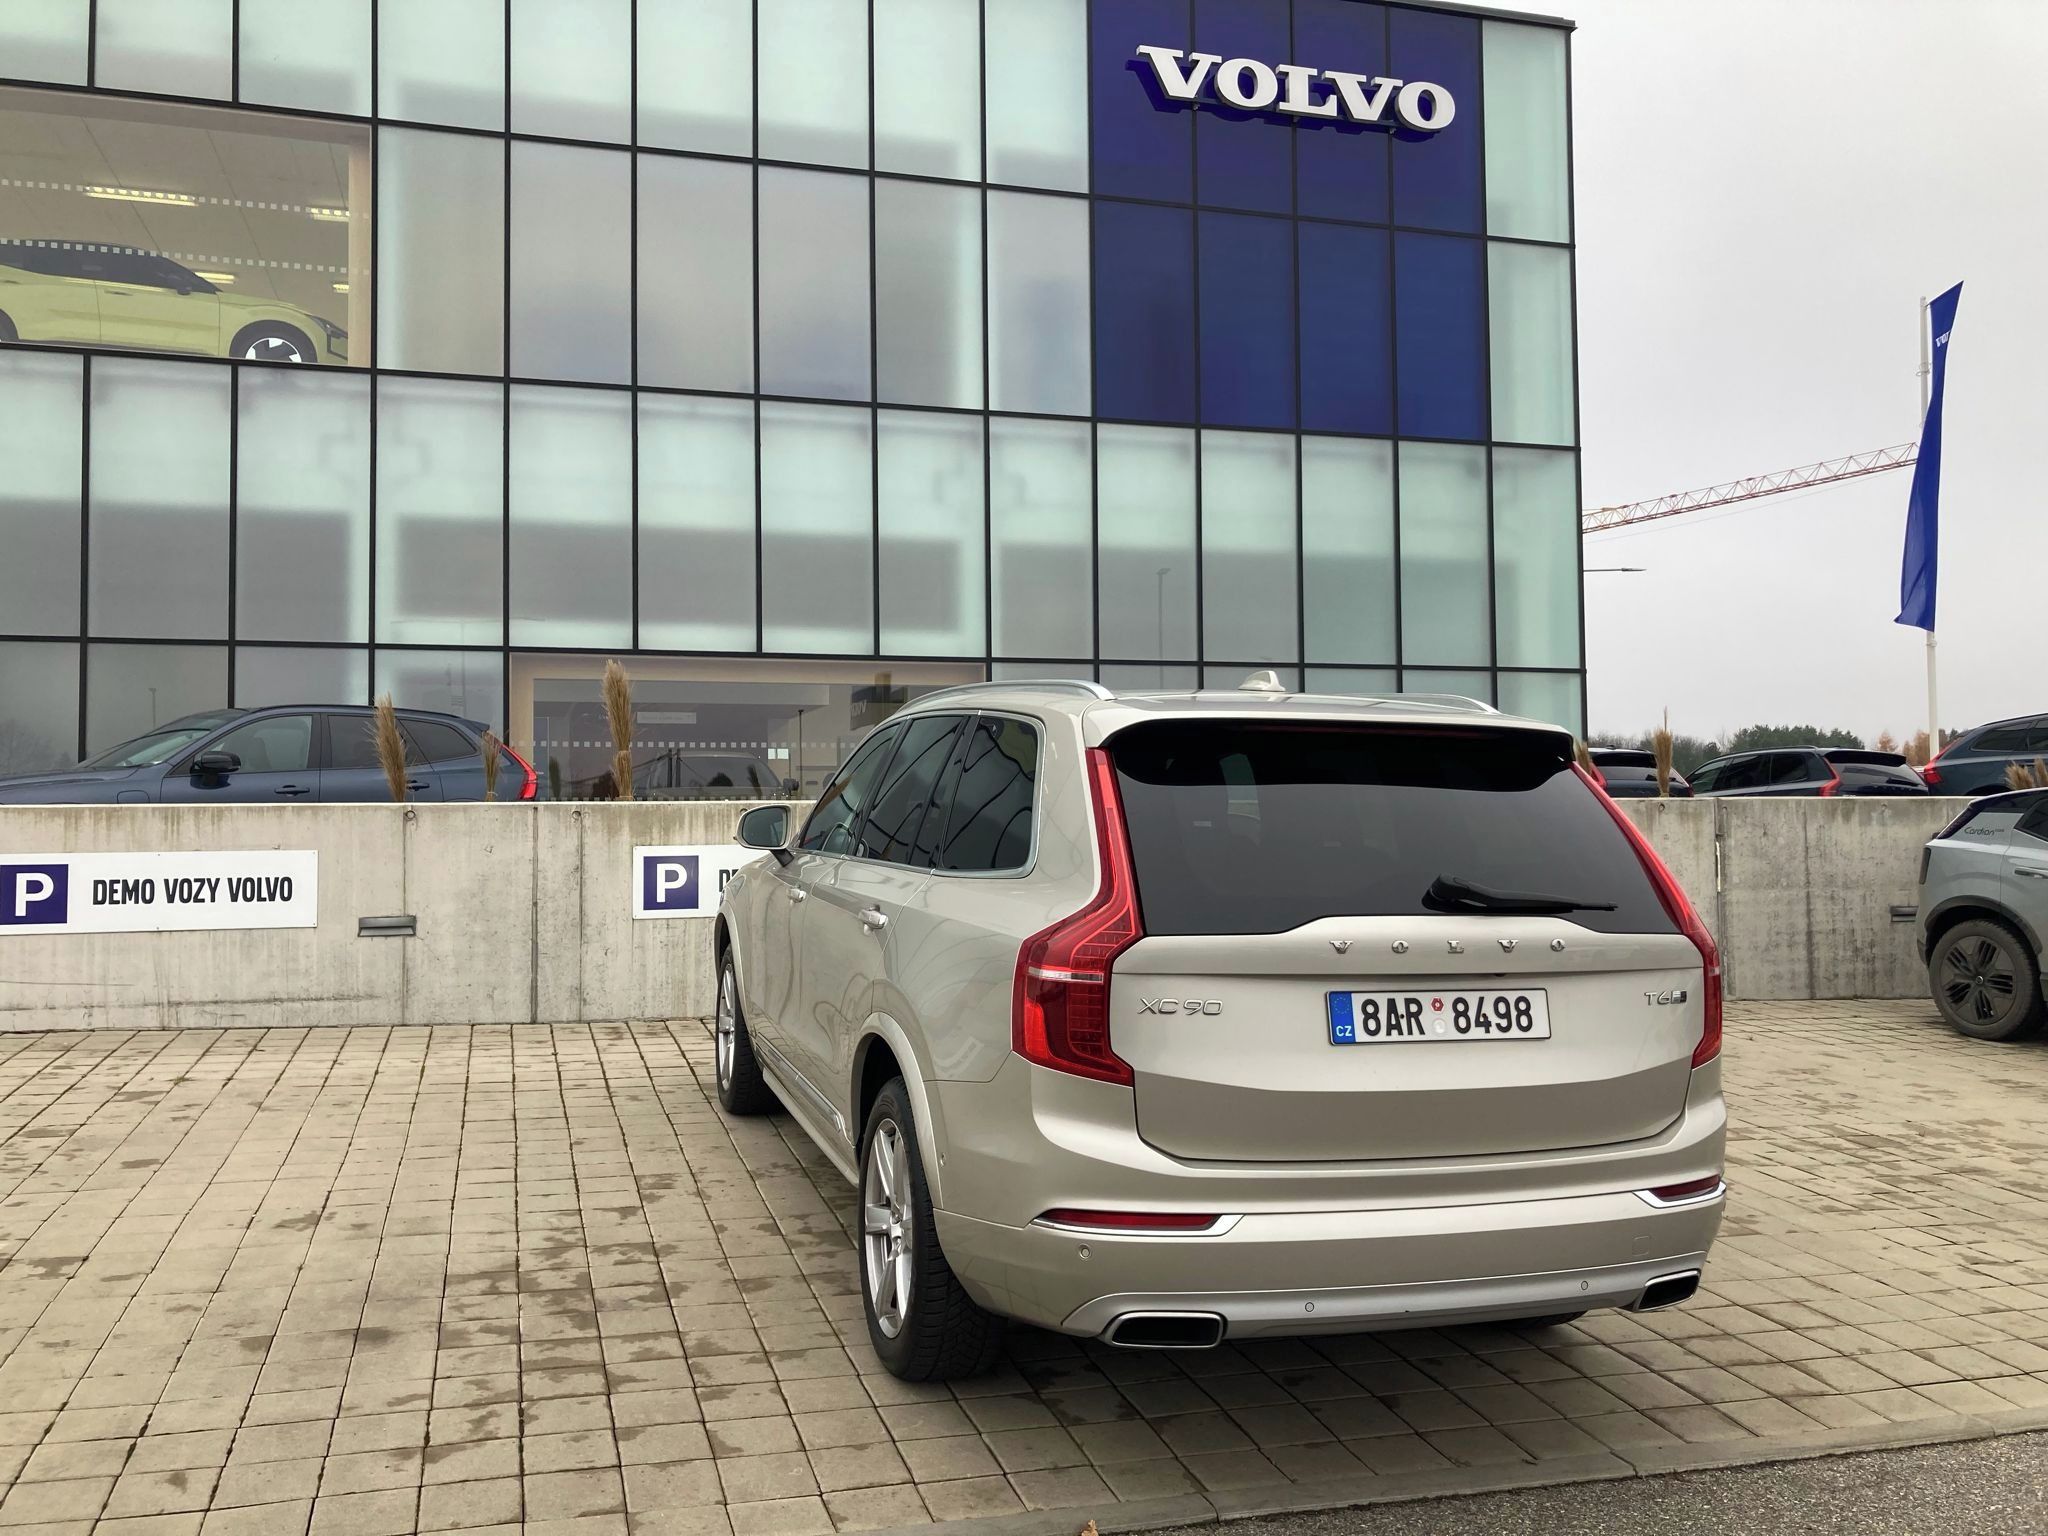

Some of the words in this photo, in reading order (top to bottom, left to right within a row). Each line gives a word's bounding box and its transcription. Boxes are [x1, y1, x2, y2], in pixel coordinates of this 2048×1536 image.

[1136, 45, 1456, 132] VOLVO
[15, 872, 54, 917] P
[92, 878, 155, 905] DEMO
[164, 877, 220, 903] VOZY
[227, 876, 293, 902] VOLVO
[656, 863, 688, 903] P
[1336, 1025, 1353, 1037] CZ
[1360, 997, 1426, 1037] 8AR
[1451, 995, 1534, 1034] 8498
